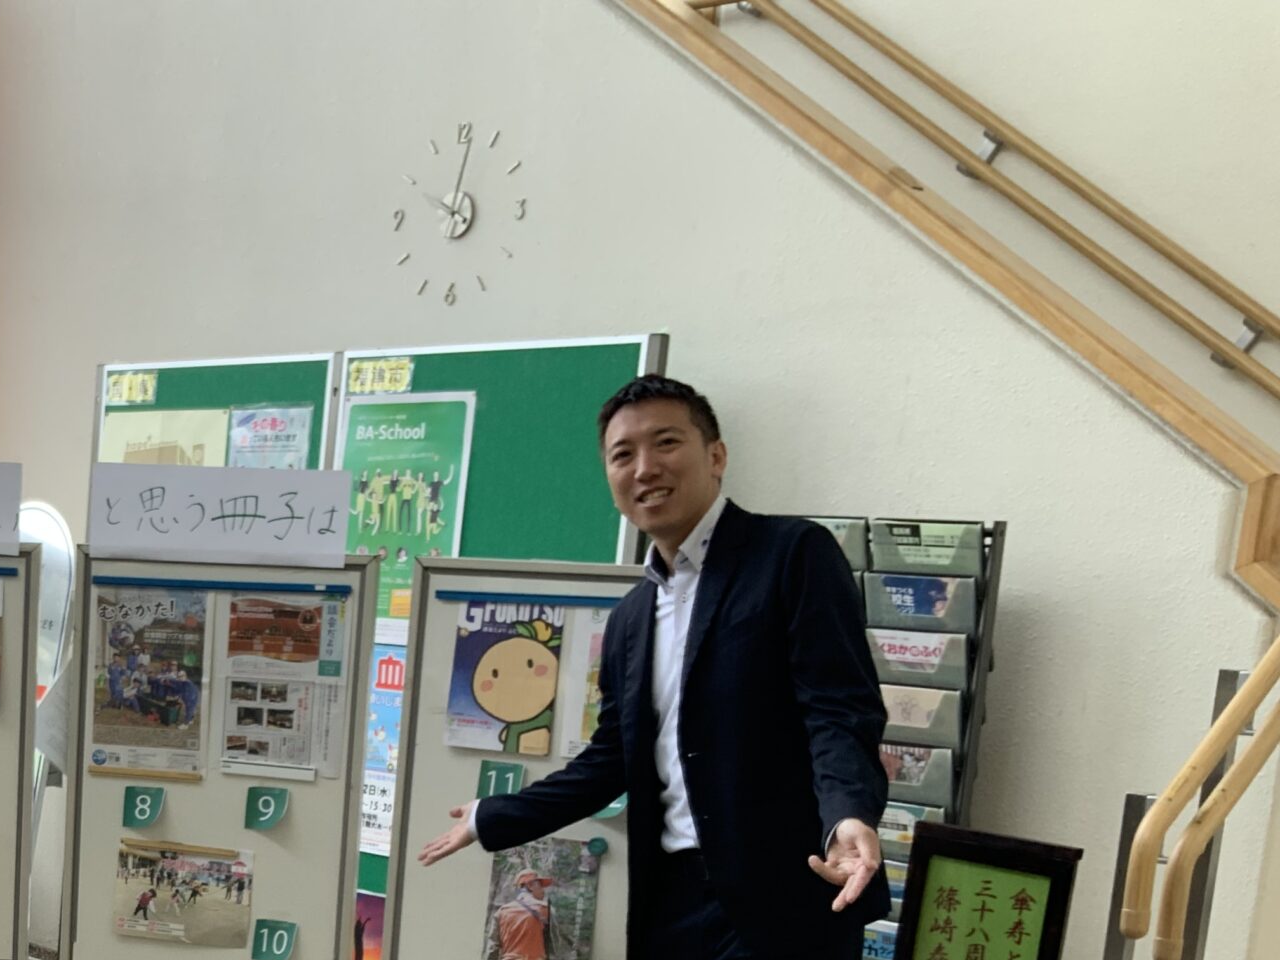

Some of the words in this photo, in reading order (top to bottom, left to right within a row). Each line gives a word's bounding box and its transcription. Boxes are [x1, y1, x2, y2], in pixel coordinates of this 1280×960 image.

[393, 208, 406, 232] 9
[515, 198, 527, 221] 3
[444, 282, 457, 306] 6
[355, 422, 427, 441] BA-School
[106, 486, 338, 541] と思う冊子は
[99, 600, 175, 619] むなかた!
[487, 770, 515, 797] 11
[134, 795, 152, 820] 8
[258, 795, 275, 821] 9
[259, 928, 289, 955] 10
